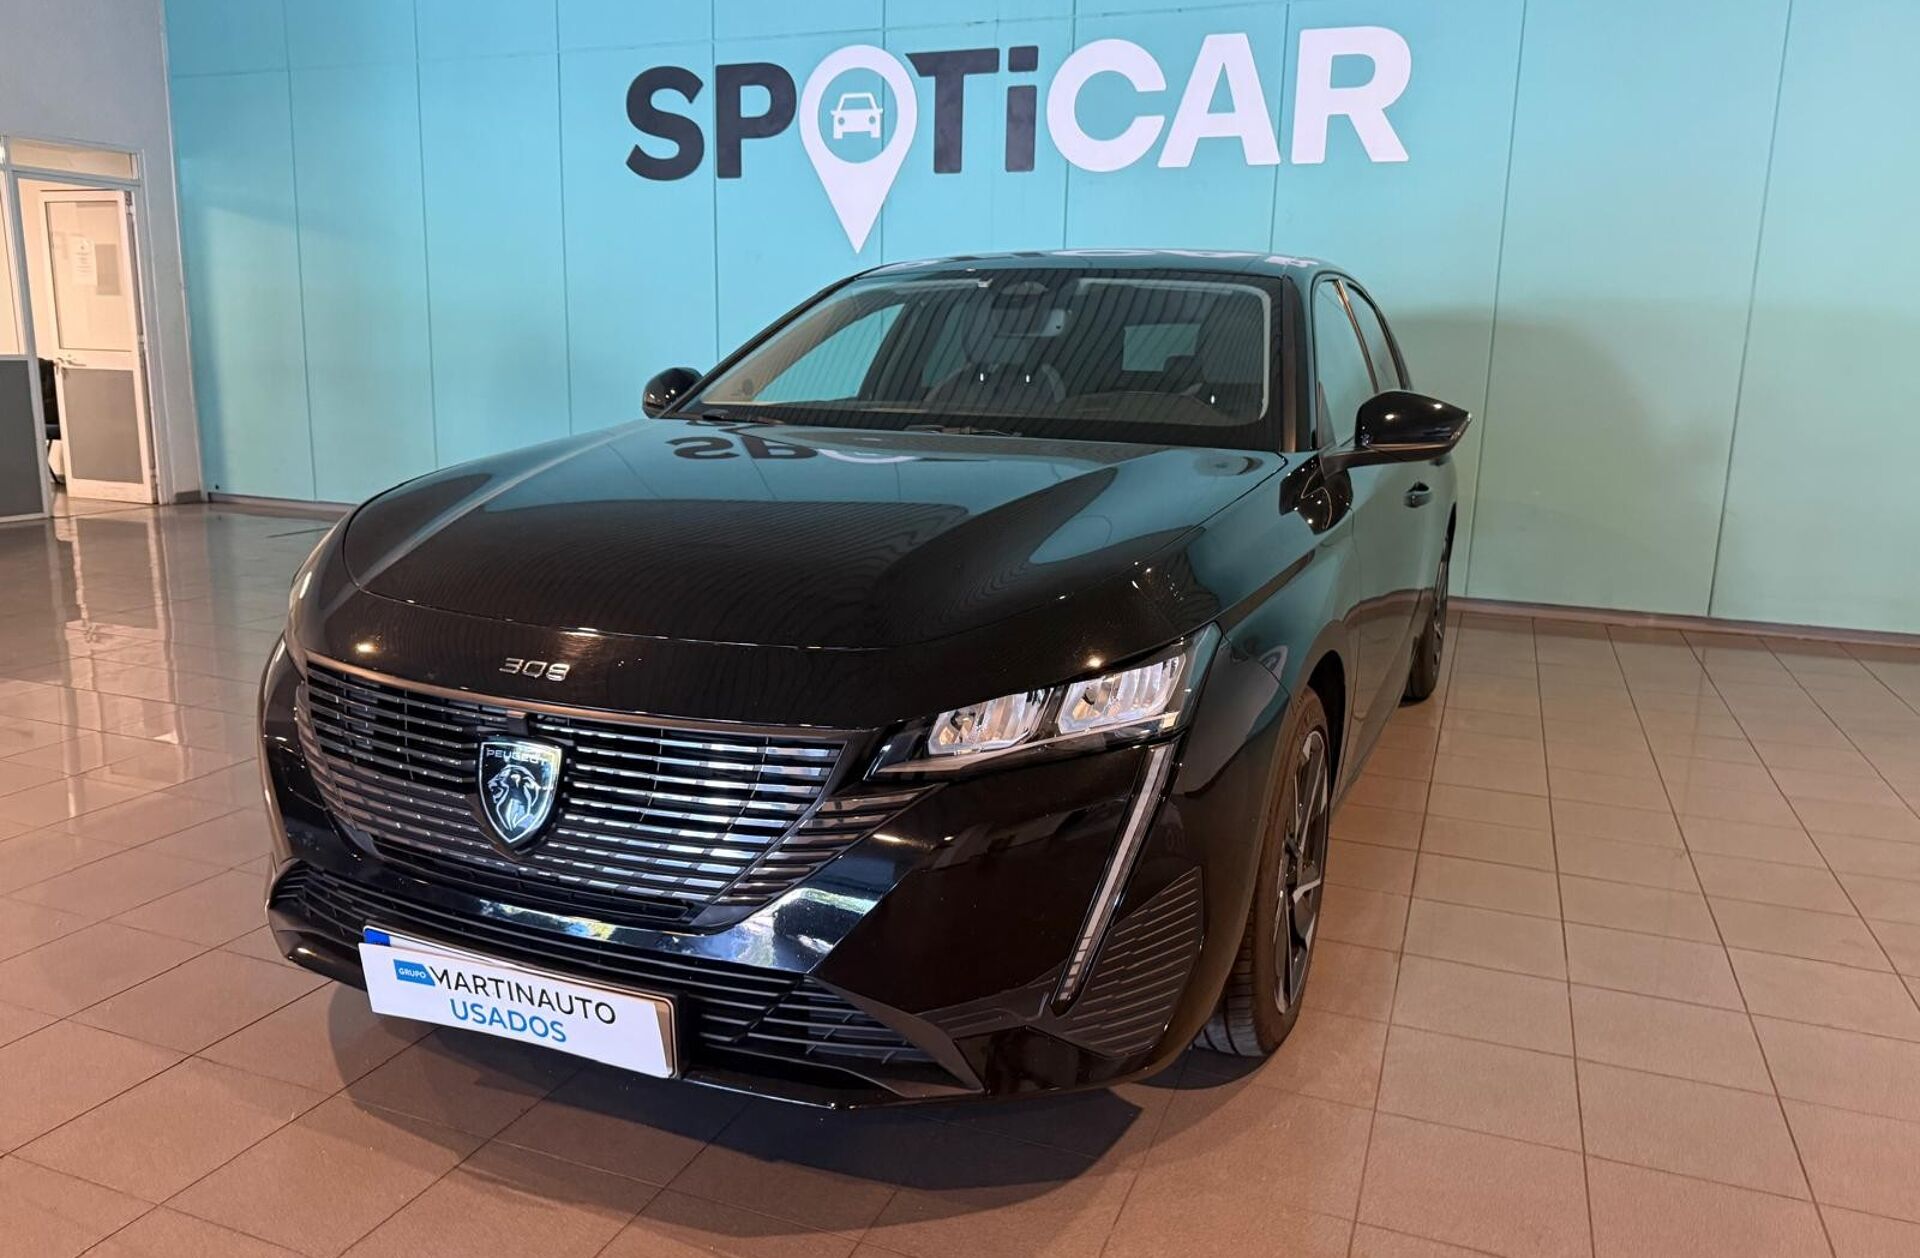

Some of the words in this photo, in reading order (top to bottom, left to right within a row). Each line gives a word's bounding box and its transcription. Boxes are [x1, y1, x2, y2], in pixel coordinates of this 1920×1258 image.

[499, 657, 570, 682] 308
[486, 748, 549, 765] PEUGEOT
[398, 967, 427, 979] GRUPO
[429, 966, 616, 1024] MARTINAUTO
[449, 998, 567, 1043] USADOS
